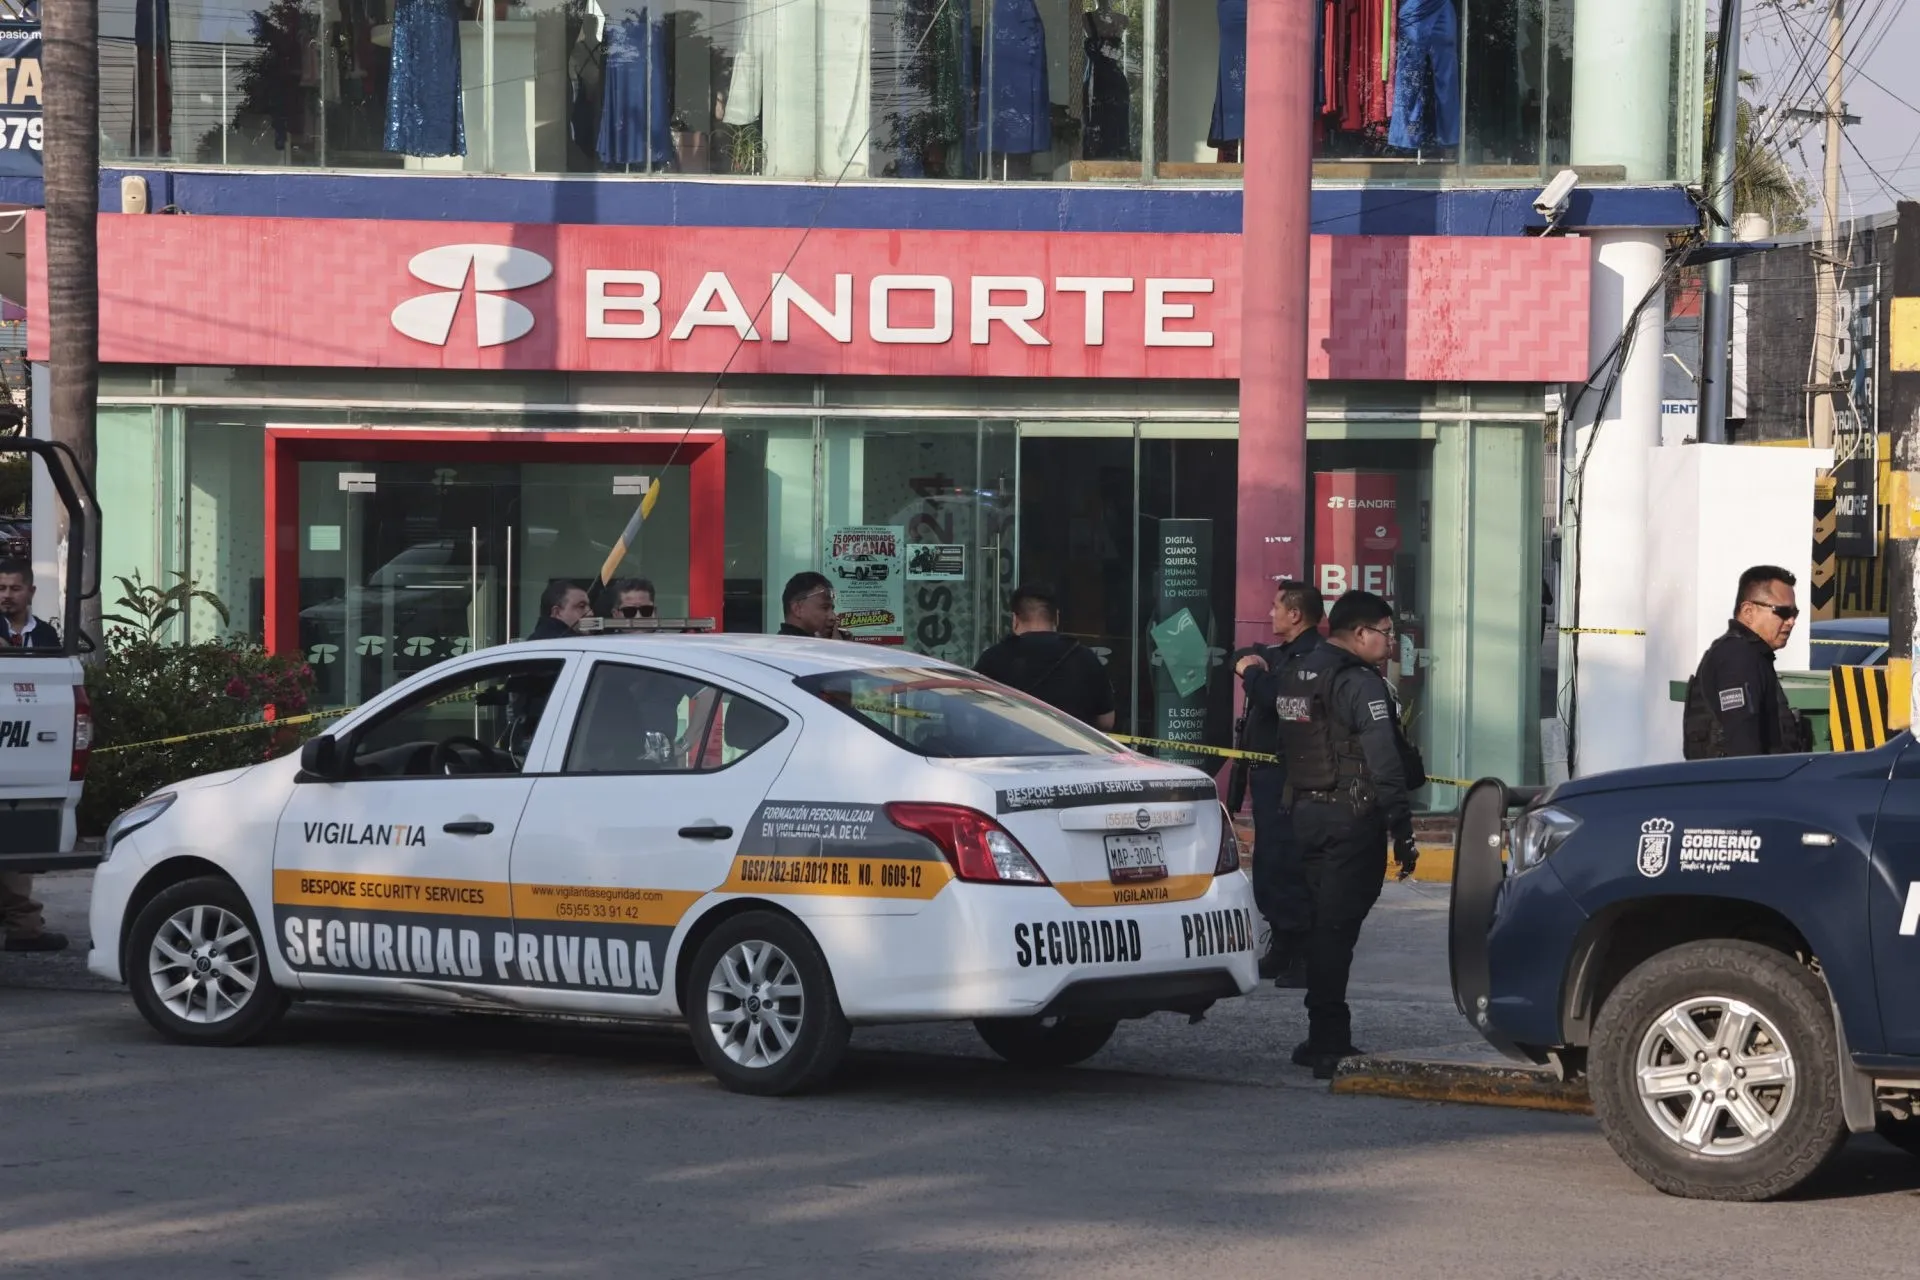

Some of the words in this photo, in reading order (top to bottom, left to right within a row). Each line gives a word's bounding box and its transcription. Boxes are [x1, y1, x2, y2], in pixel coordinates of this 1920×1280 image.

[585, 268, 1215, 347] BANORTE
[1165, 536, 1194, 544] DIGITAL
[853, 542, 896, 557] GANAR
[1165, 589, 1176, 597] LO
[1168, 708, 1178, 717] EL
[1007, 784, 1056, 800] BESPOKE
[1057, 781, 1103, 796] SECURITY
[1105, 779, 1144, 792] SERVICES
[762, 805, 809, 820] FORMACIÓN
[809, 808, 874, 822] PERSONALIZADA
[304, 822, 426, 846] VIGILANTIA
[762, 823, 774, 837] EN
[839, 825, 850, 839] DE
[852, 826, 867, 840] C.V.
[1682, 835, 1761, 850] GOBIERNO
[1110, 846, 1164, 867] MAP-300-C
[1680, 848, 1759, 863] MUNICIPAL
[831, 863, 851, 885] REG.
[859, 864, 873, 886] NO.
[881, 865, 921, 888] 0609-12
[301, 879, 356, 896] BESPOKE
[360, 882, 421, 900] SECURITY
[425, 887, 484, 904] SERVICES
[531, 886, 663, 901] www.vigilantiaseguridad.com
[1113, 887, 1168, 902] VIGILANTIA
[556, 903, 590, 918] (55)55
[593, 905, 605, 917] 33
[610, 906, 621, 918] 91
[625, 906, 638, 919] 42
[1014, 919, 1141, 968] SEGURIDAD
[284, 916, 483, 977] SEGURIDAD
[494, 931, 659, 990] PRIVADA
